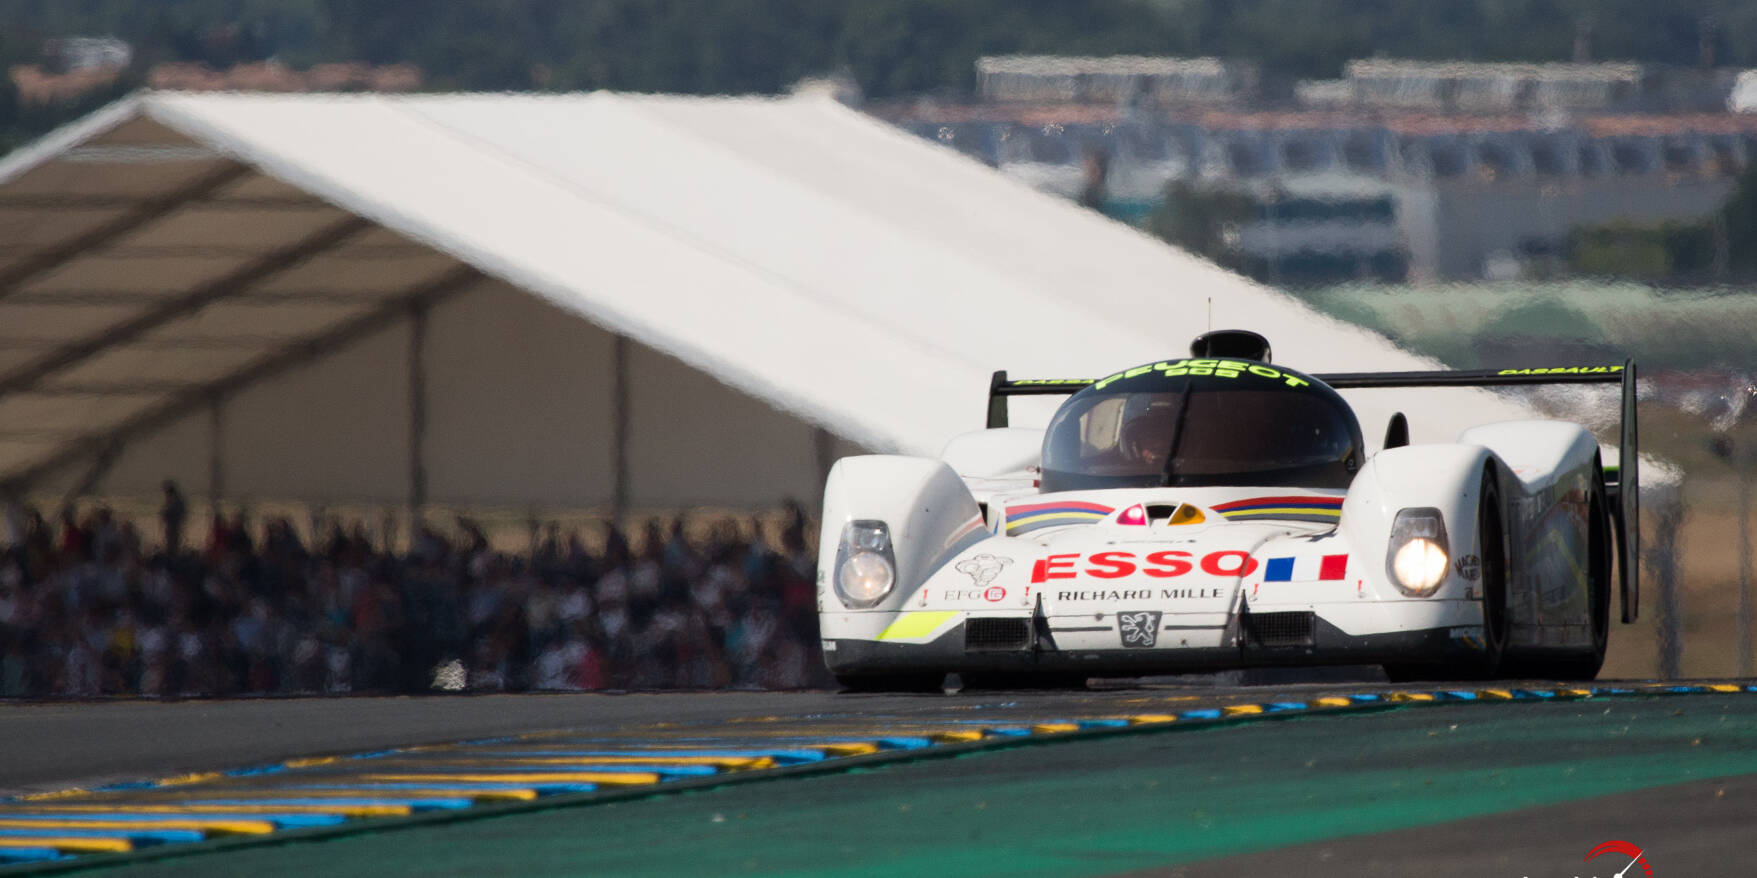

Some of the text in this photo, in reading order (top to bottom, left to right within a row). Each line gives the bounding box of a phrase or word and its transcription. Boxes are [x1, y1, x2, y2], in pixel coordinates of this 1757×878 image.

[1095, 359, 1309, 390] PEUGEOT
[1498, 365, 1625, 375] DASSAULT
[1030, 550, 1259, 583] ESSO
[1058, 588, 1225, 601] RICHARD MILLE
